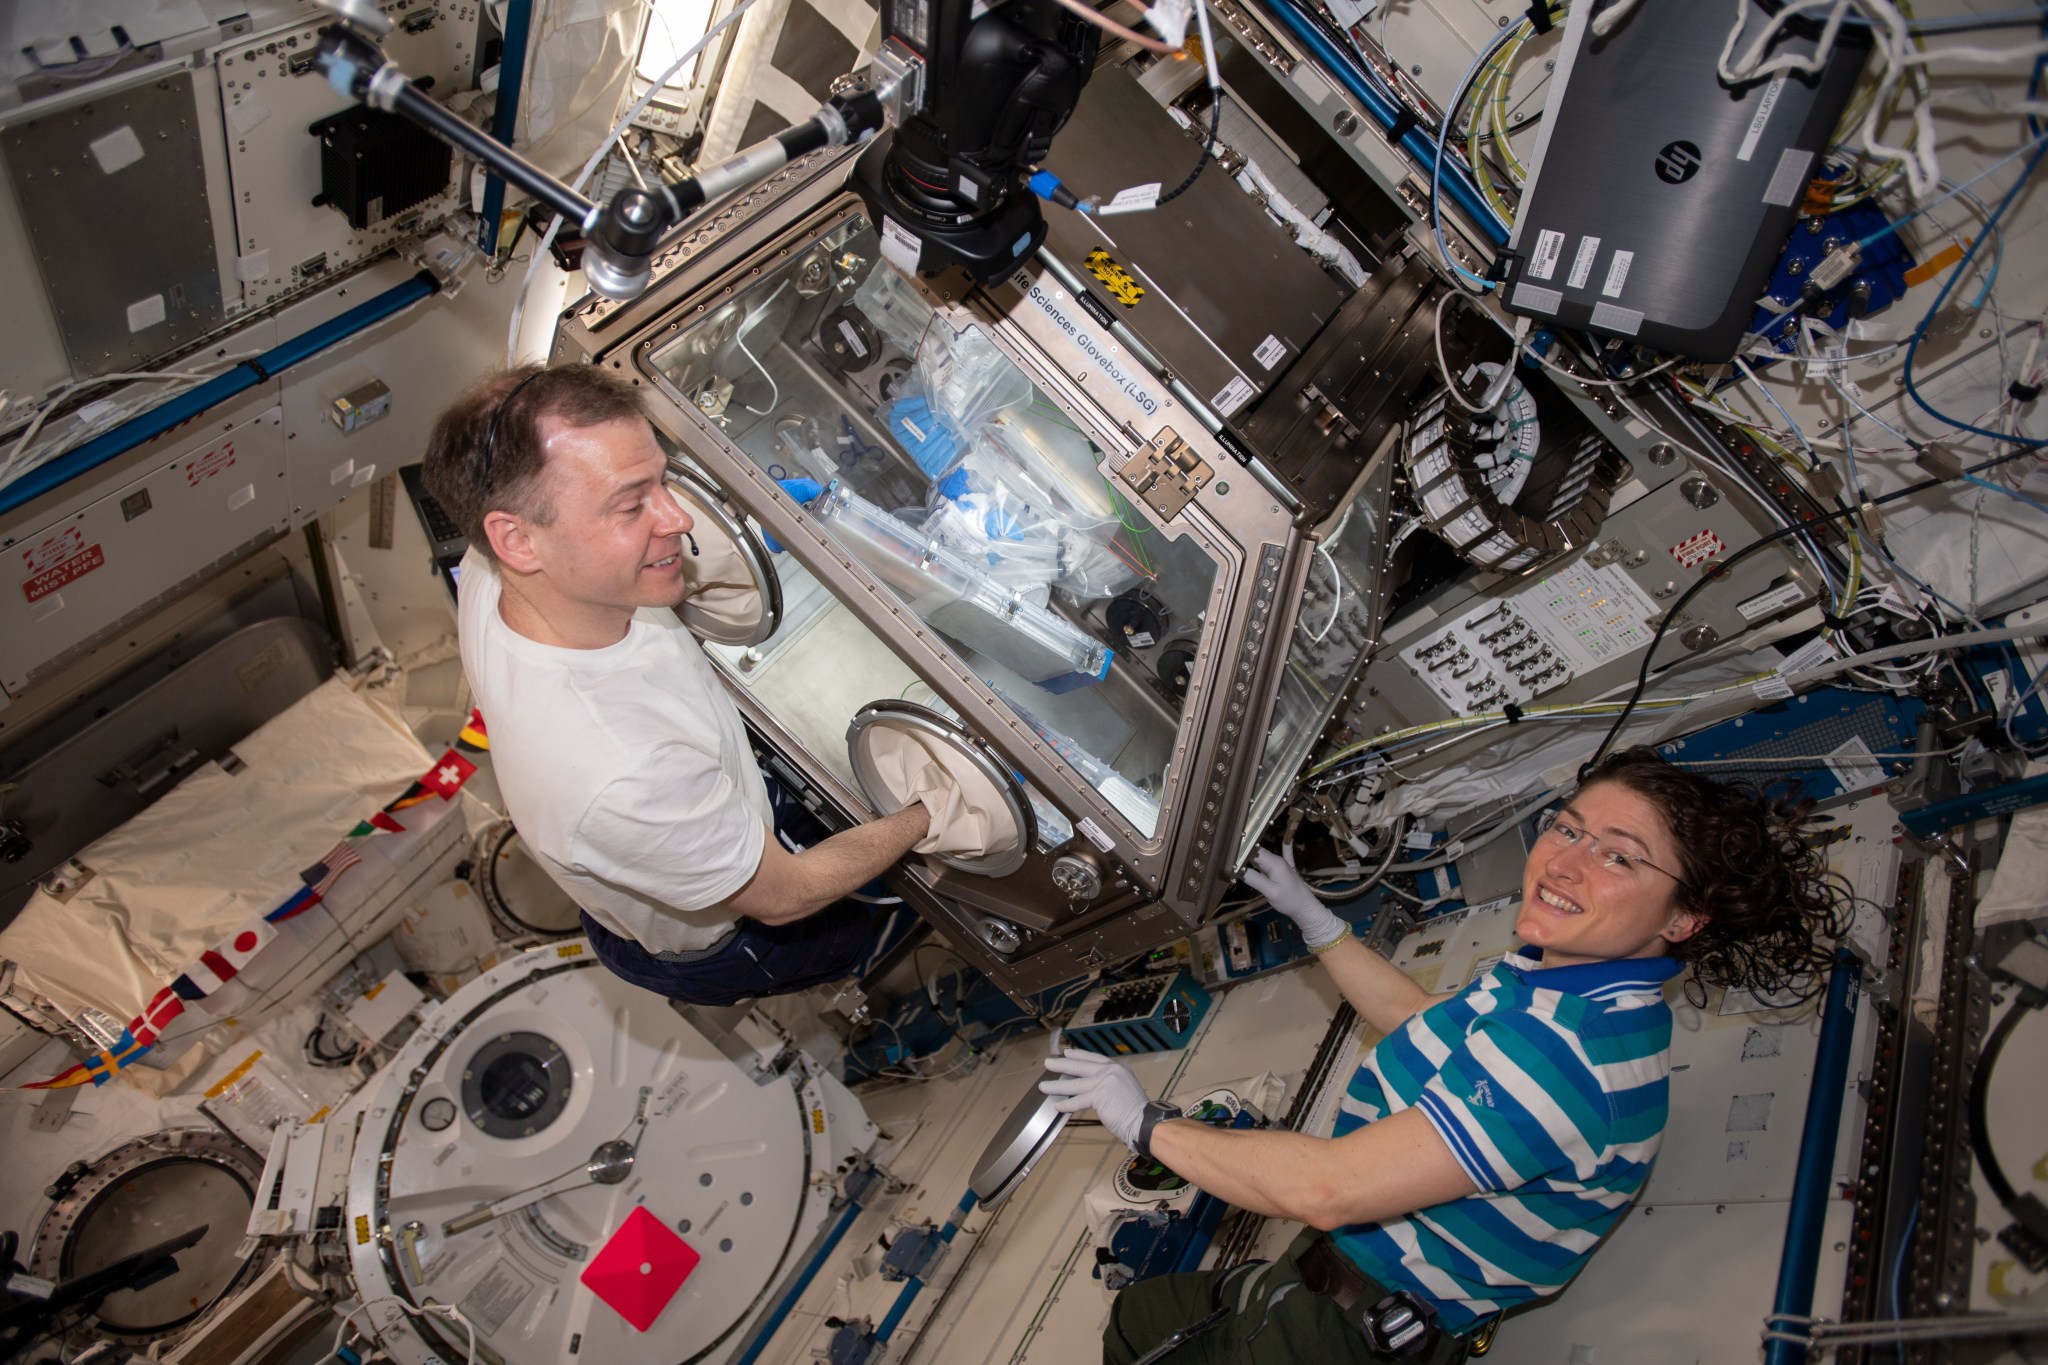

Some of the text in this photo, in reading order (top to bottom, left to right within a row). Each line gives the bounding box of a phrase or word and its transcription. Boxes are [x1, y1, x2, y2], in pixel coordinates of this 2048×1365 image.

[1751, 115, 1765, 135] LSG
[1656, 141, 1702, 185] hp
[926, 214, 946, 222] Canon
[1100, 258, 1123, 280] WARNING
[1102, 267, 1113, 278] HOT
[1569, 237, 1589, 284] FIRMWARE VERSION
[1079, 296, 1109, 325] ILLUMINATION
[1010, 269, 1160, 417] ife Sciences Glovebox (LSG)
[1218, 434, 1247, 463] ILLUMINATION
[41, 542, 68, 558] FIRE
[1682, 540, 1712, 558] FIRE PORT
[29, 555, 103, 599] MIST PFE
[34, 550, 94, 586] WATER
[1478, 903, 1493, 913] EPS
